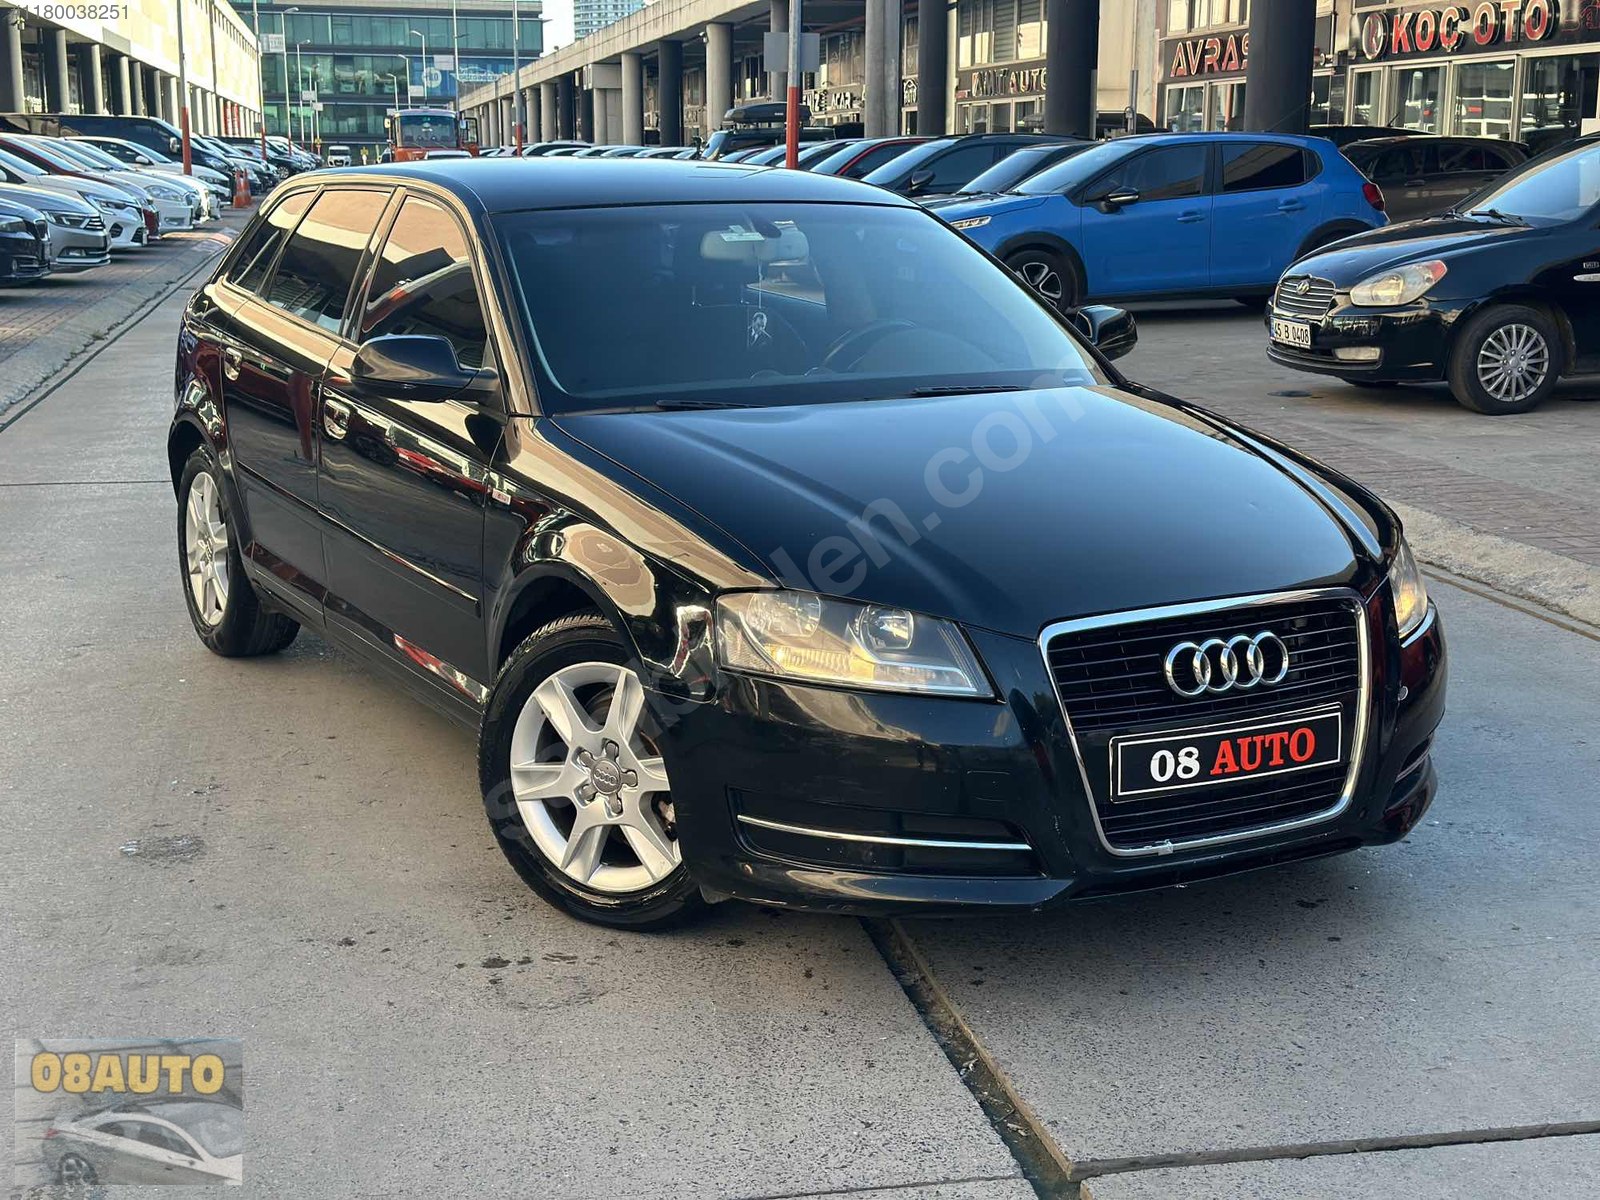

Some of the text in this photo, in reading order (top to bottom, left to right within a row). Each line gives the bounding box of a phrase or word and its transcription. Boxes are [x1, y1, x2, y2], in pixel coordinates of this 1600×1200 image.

[1391, 6, 1464, 54] KOÇ
[1472, 0, 1549, 45] OTO
[1284, 324, 1290, 339] B
[1292, 326, 1309, 343] 0408
[1150, 727, 1316, 782] 08 AUTO
